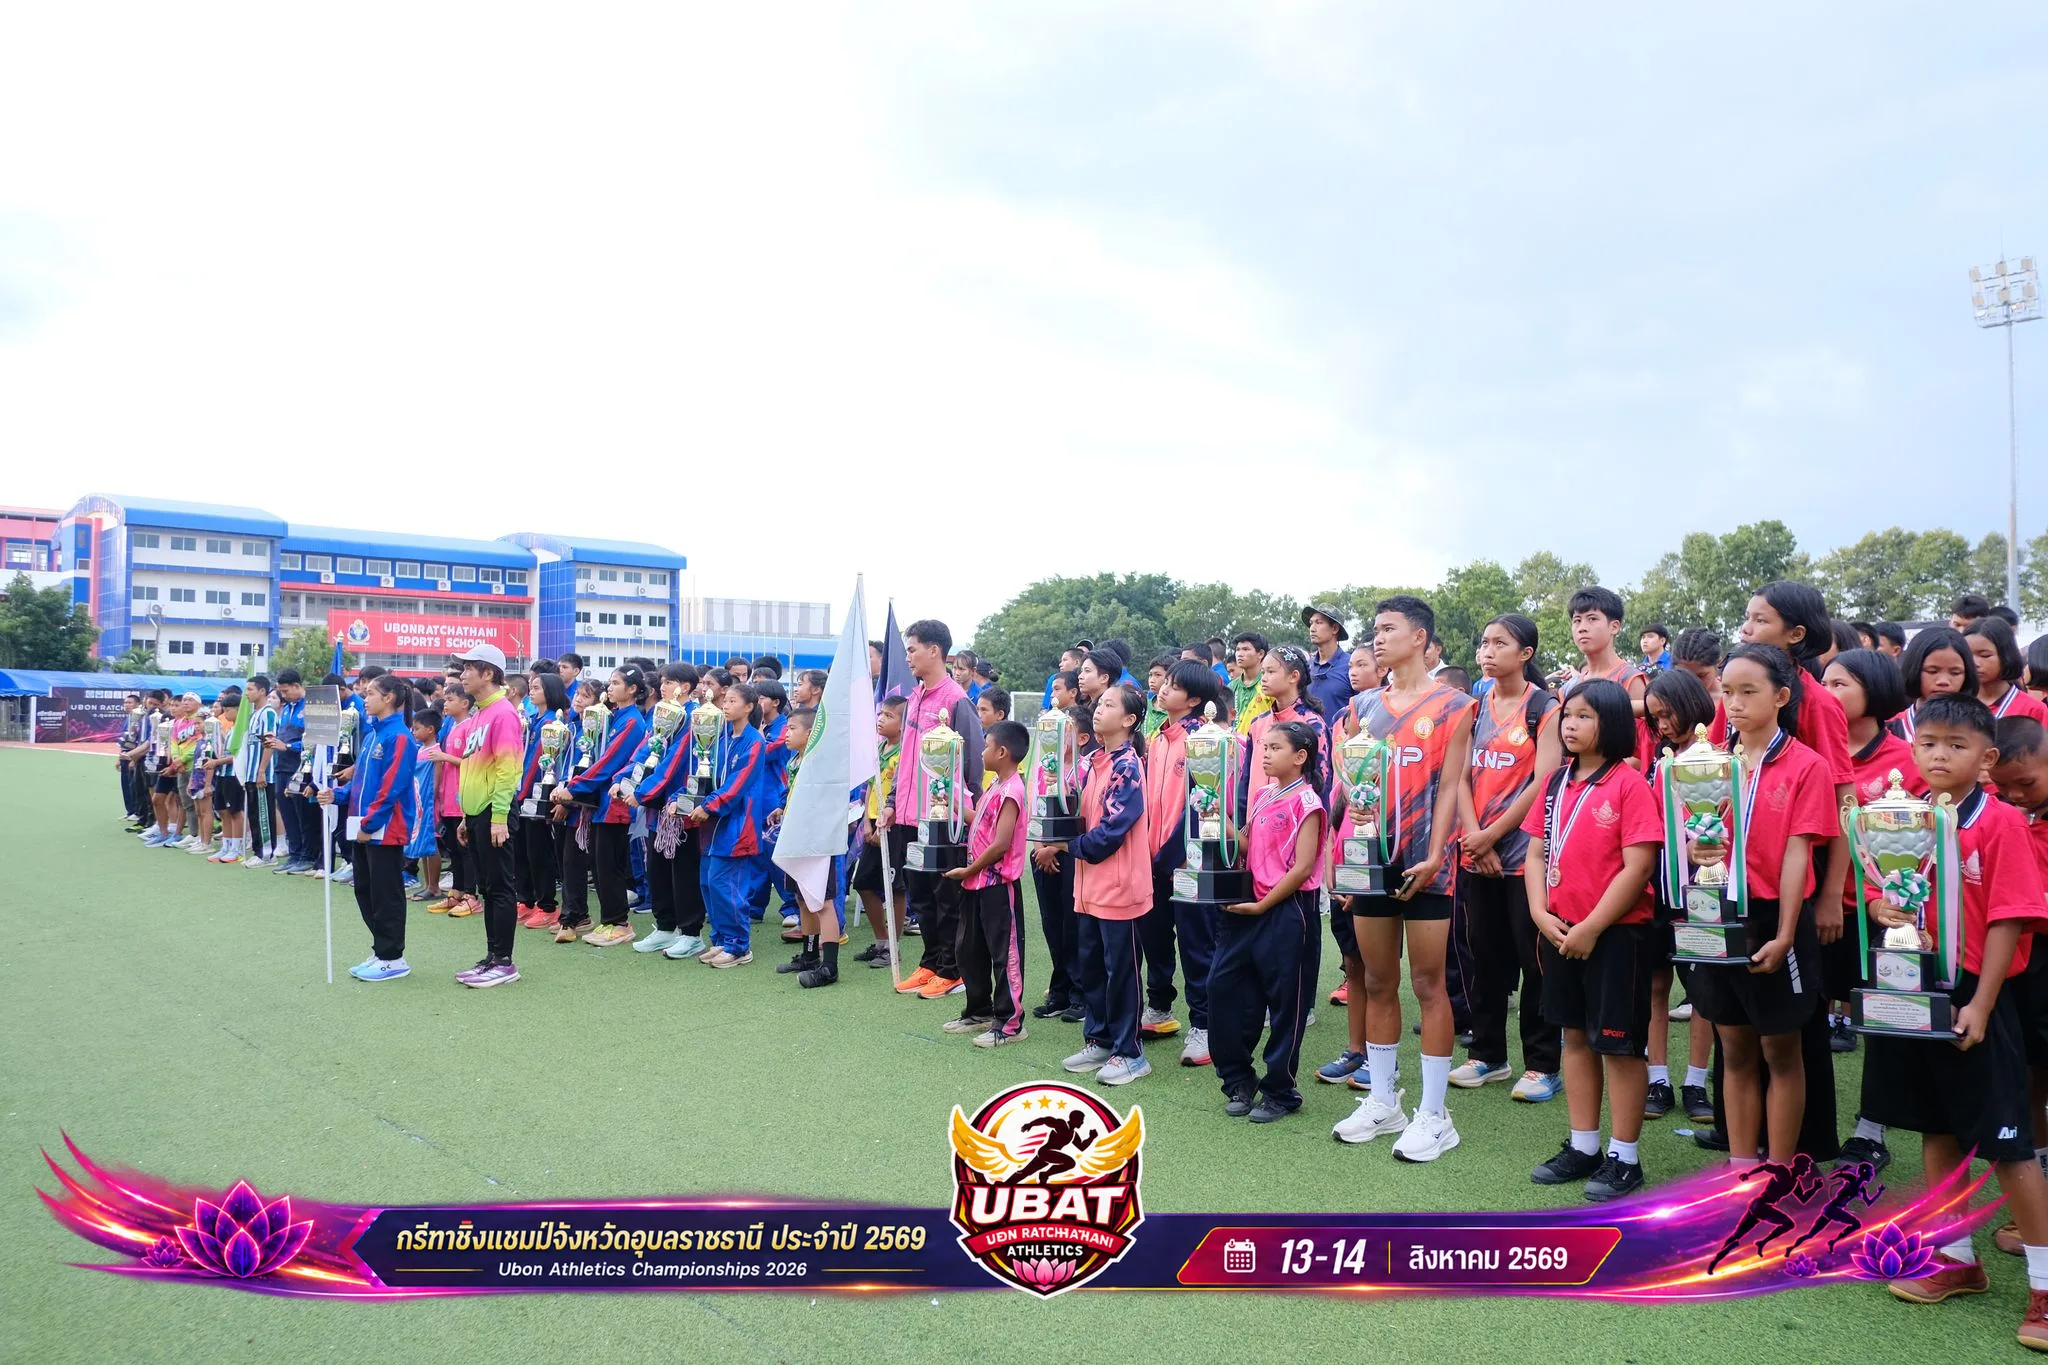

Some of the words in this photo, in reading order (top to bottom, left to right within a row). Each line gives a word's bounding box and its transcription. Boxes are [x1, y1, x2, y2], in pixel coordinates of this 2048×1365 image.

[383, 622, 498, 638] UBONRATCHATHANI
[396, 635, 441, 648] SPORTS
[1387, 745, 1424, 768] NP
[1471, 748, 1516, 771] KNP
[1997, 1126, 2018, 1140] Ari
